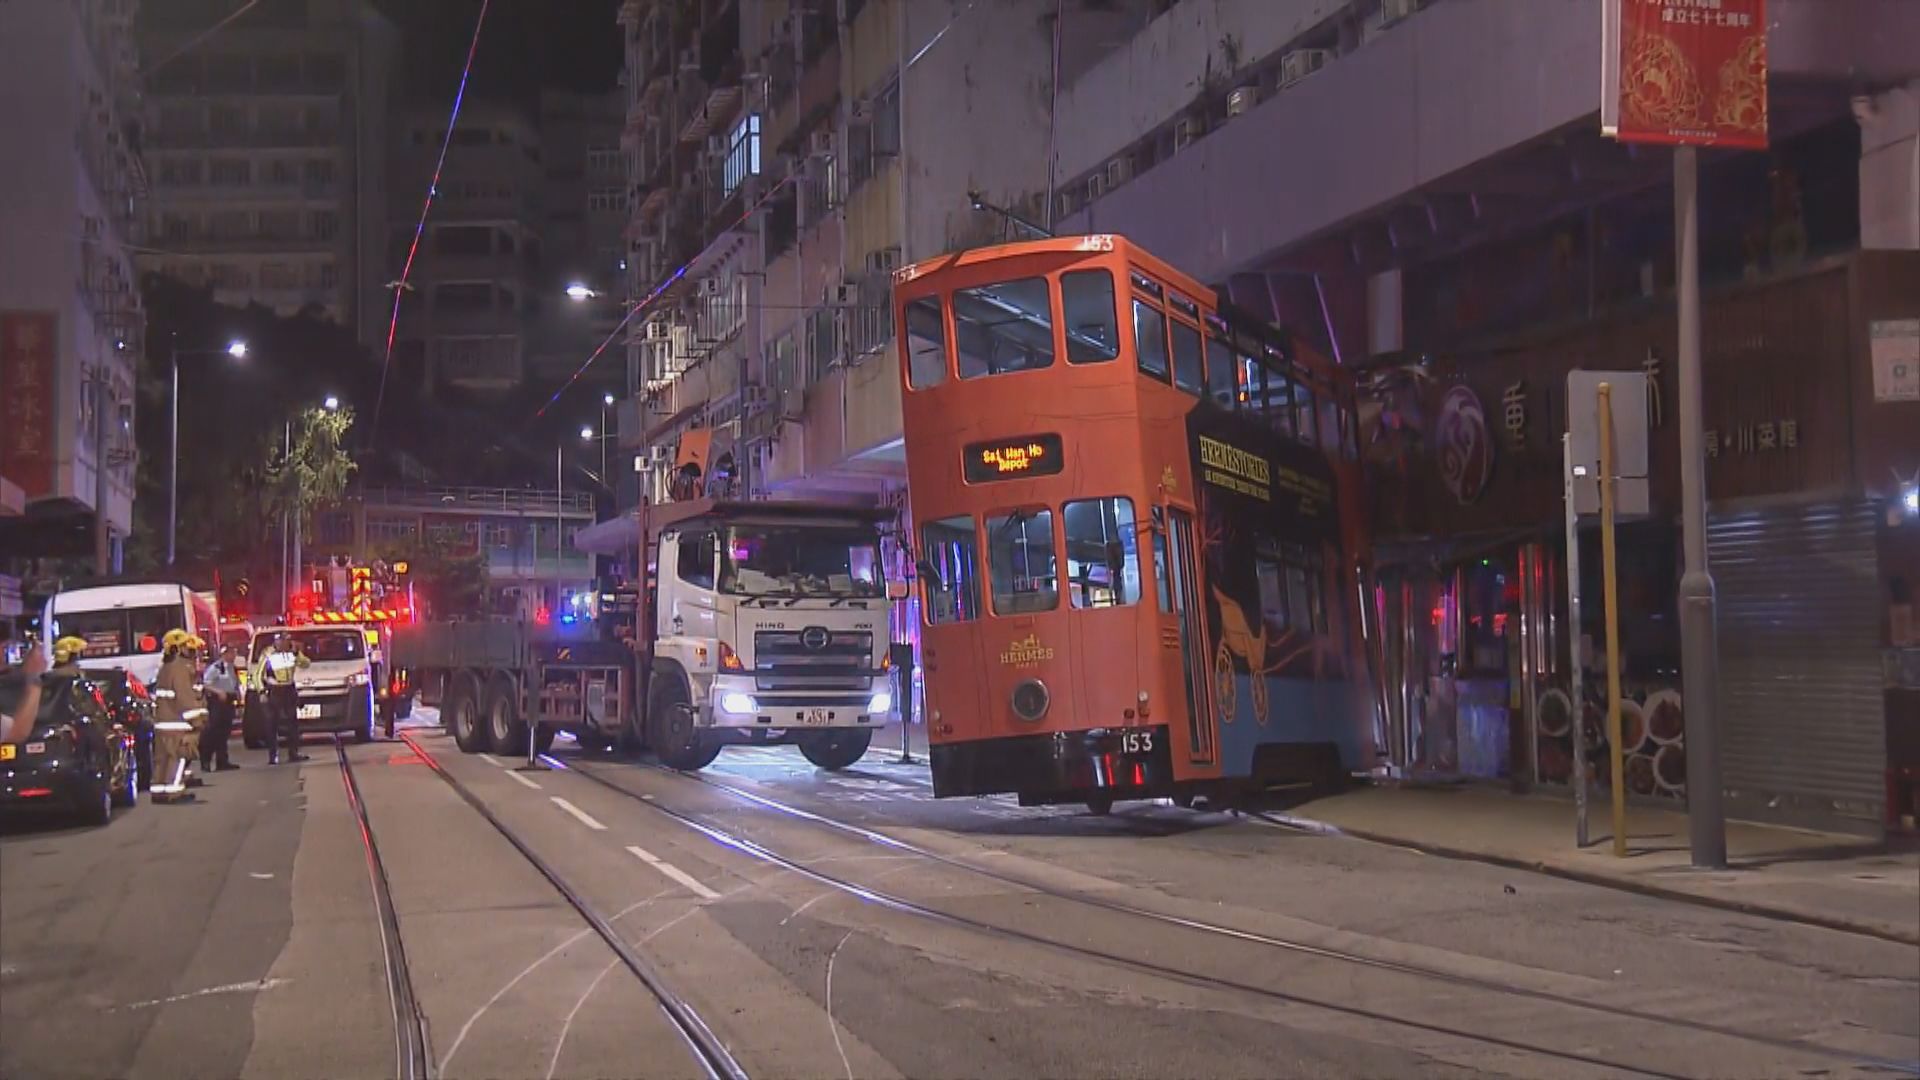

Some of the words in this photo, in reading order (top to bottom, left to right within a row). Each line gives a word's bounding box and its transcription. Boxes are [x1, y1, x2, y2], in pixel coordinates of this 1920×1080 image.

[983, 449, 1000, 464] Sai
[1029, 443, 1043, 457] Ho
[999, 458, 1029, 472] Depot
[1122, 732, 1152, 752] 153
